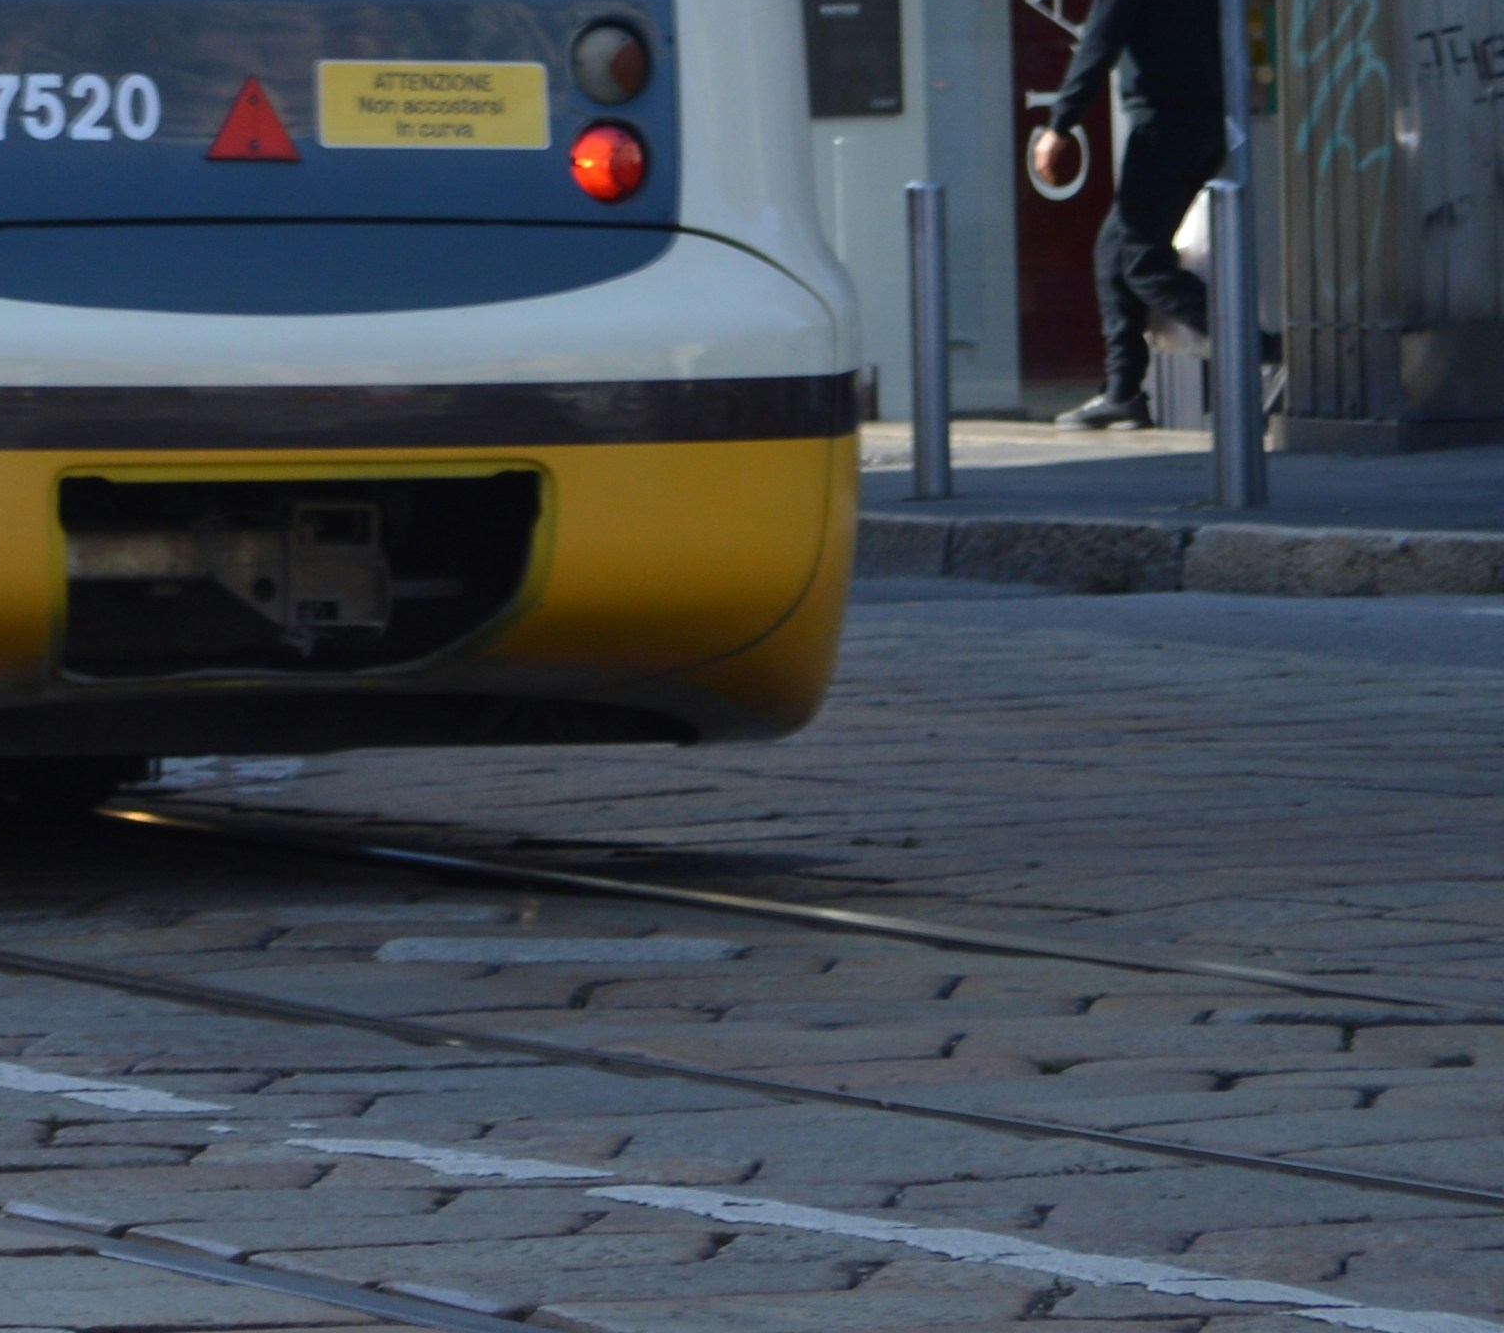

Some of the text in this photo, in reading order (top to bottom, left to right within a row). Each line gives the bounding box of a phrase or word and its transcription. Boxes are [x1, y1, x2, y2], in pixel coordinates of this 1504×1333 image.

[374, 73, 493, 92] ATTENZIONE
[357, 97, 504, 115] Non accostarsi
[418, 124, 474, 139] curva
